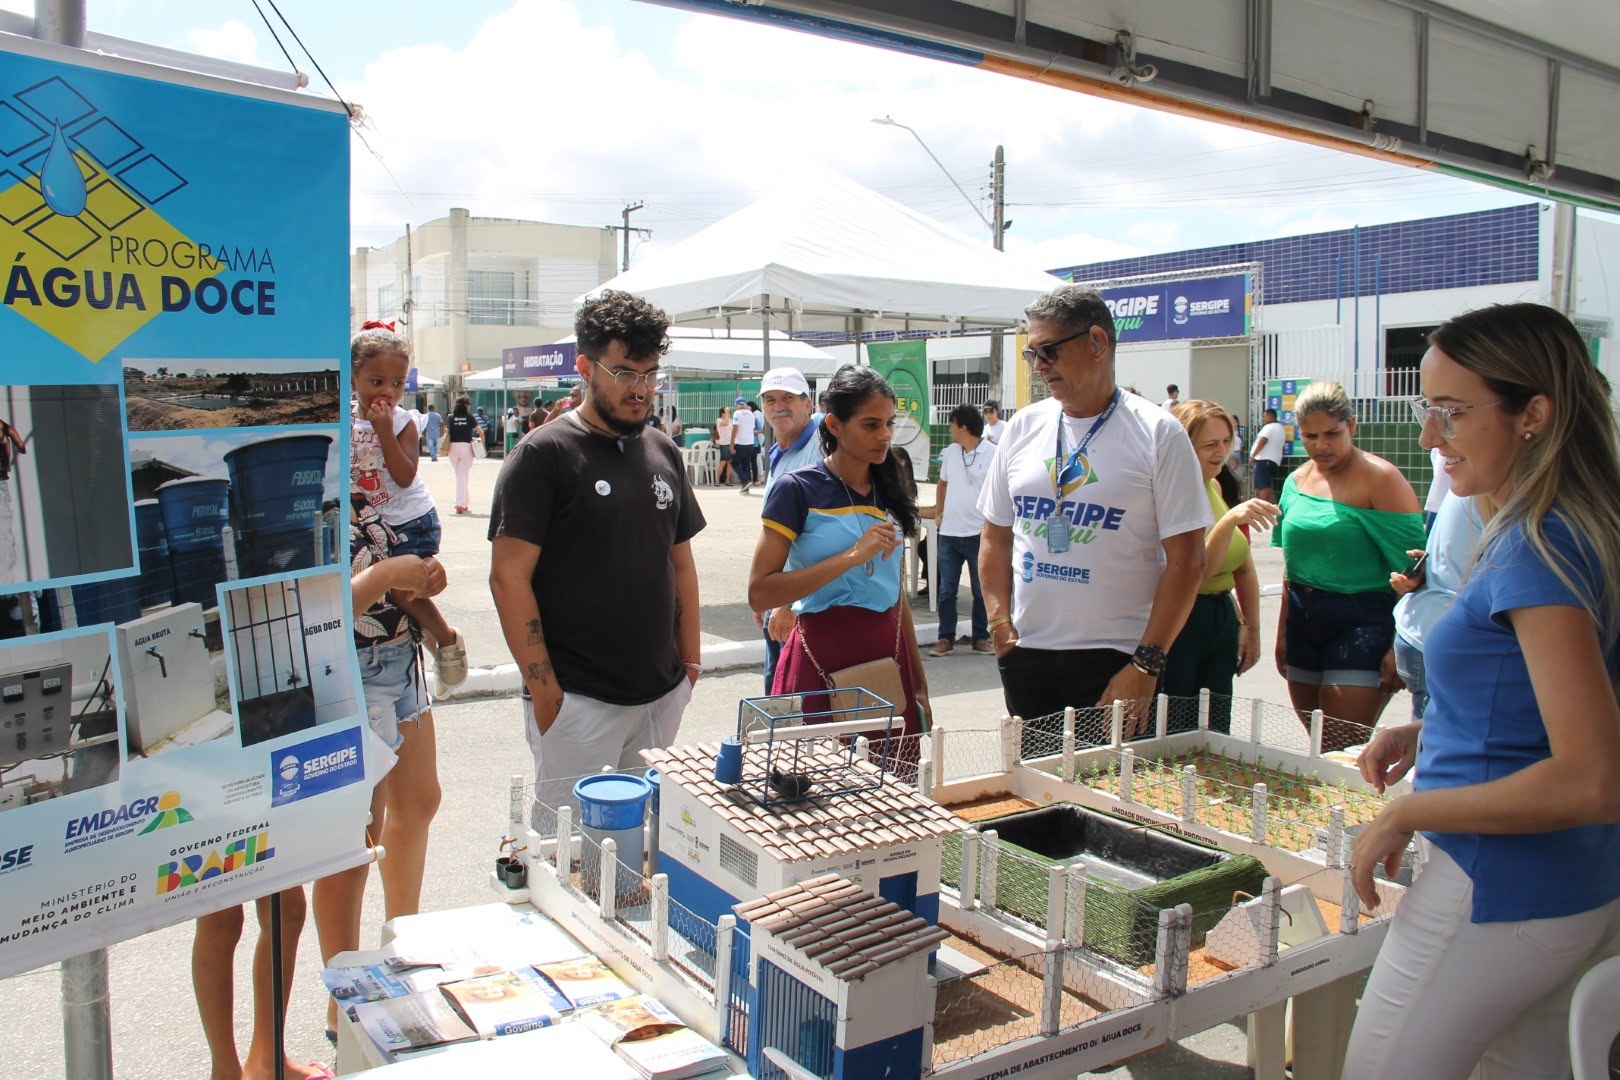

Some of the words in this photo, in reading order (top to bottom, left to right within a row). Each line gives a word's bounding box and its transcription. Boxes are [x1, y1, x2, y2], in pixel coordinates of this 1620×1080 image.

[110, 235, 276, 274] PROGRAMA
[3, 252, 147, 311] ÁGUA
[161, 275, 276, 316] DOCE
[1104, 295, 1159, 318] RGIPE
[1190, 299, 1230, 311] SERGIPE
[1113, 309, 1144, 341] qui
[523, 350, 563, 370] HIDRATAÇÃO
[1013, 495, 1126, 531] SERGIPE
[1033, 521, 1097, 545] aui
[1036, 562, 1090, 579] SERGIPE
[152, 628, 171, 641] BRUTA
[323, 619, 342, 632] DOCE
[303, 745, 357, 775] SERGIPE
[304, 768, 328, 780] GOVERNO
[329, 764, 338, 772] DO
[338, 759, 357, 770] ESTADO
[1111, 806, 1135, 819] UNIDADE
[170, 835, 222, 857] GOVERNO
[226, 821, 270, 839] FEDERAL
[156, 831, 276, 896] BRASIL
[40, 879, 115, 910] MINISTÉRIO
[121, 872, 137, 884] DO
[164, 889, 192, 902] UNIÃO
[202, 864, 265, 891] RECONSTRUÇÃO
[0, 919, 68, 944] MUDANÇA
[74, 911, 91, 922] DO
[97, 897, 135, 915] CLIMA
[21, 911, 55, 926] MEIO
[61, 888, 125, 915] AMBIENTE
[130, 885, 137, 893] E
[504, 1018, 544, 1035] Governo
[1010, 1063, 1022, 1074] DE
[1023, 1041, 1088, 1071] ABASTECIMENTO
[1101, 1030, 1121, 1043] ÁGUA
[1122, 1022, 1142, 1036] DOCE
